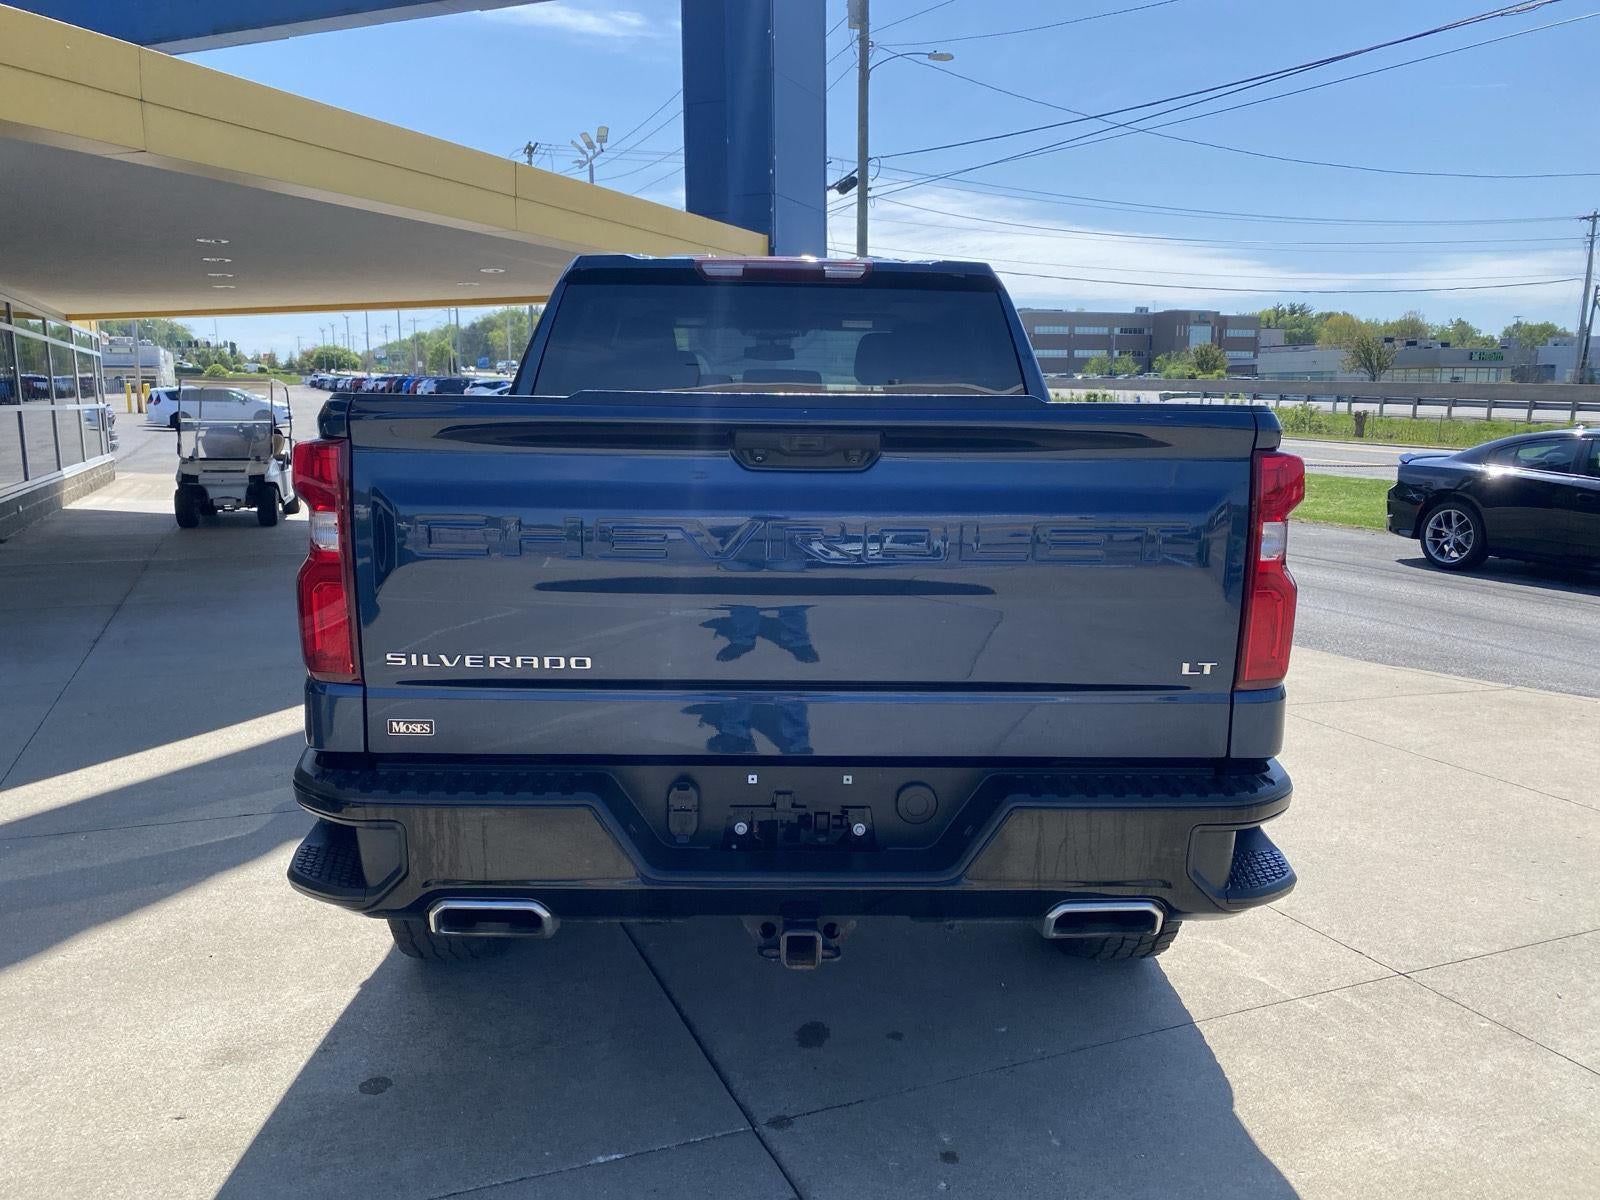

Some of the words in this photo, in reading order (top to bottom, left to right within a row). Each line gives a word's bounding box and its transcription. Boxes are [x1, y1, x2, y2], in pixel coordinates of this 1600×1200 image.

[413, 513, 1192, 564] CHEVROLET
[385, 652, 593, 670] SILVERADO
[1181, 662, 1218, 675] LT
